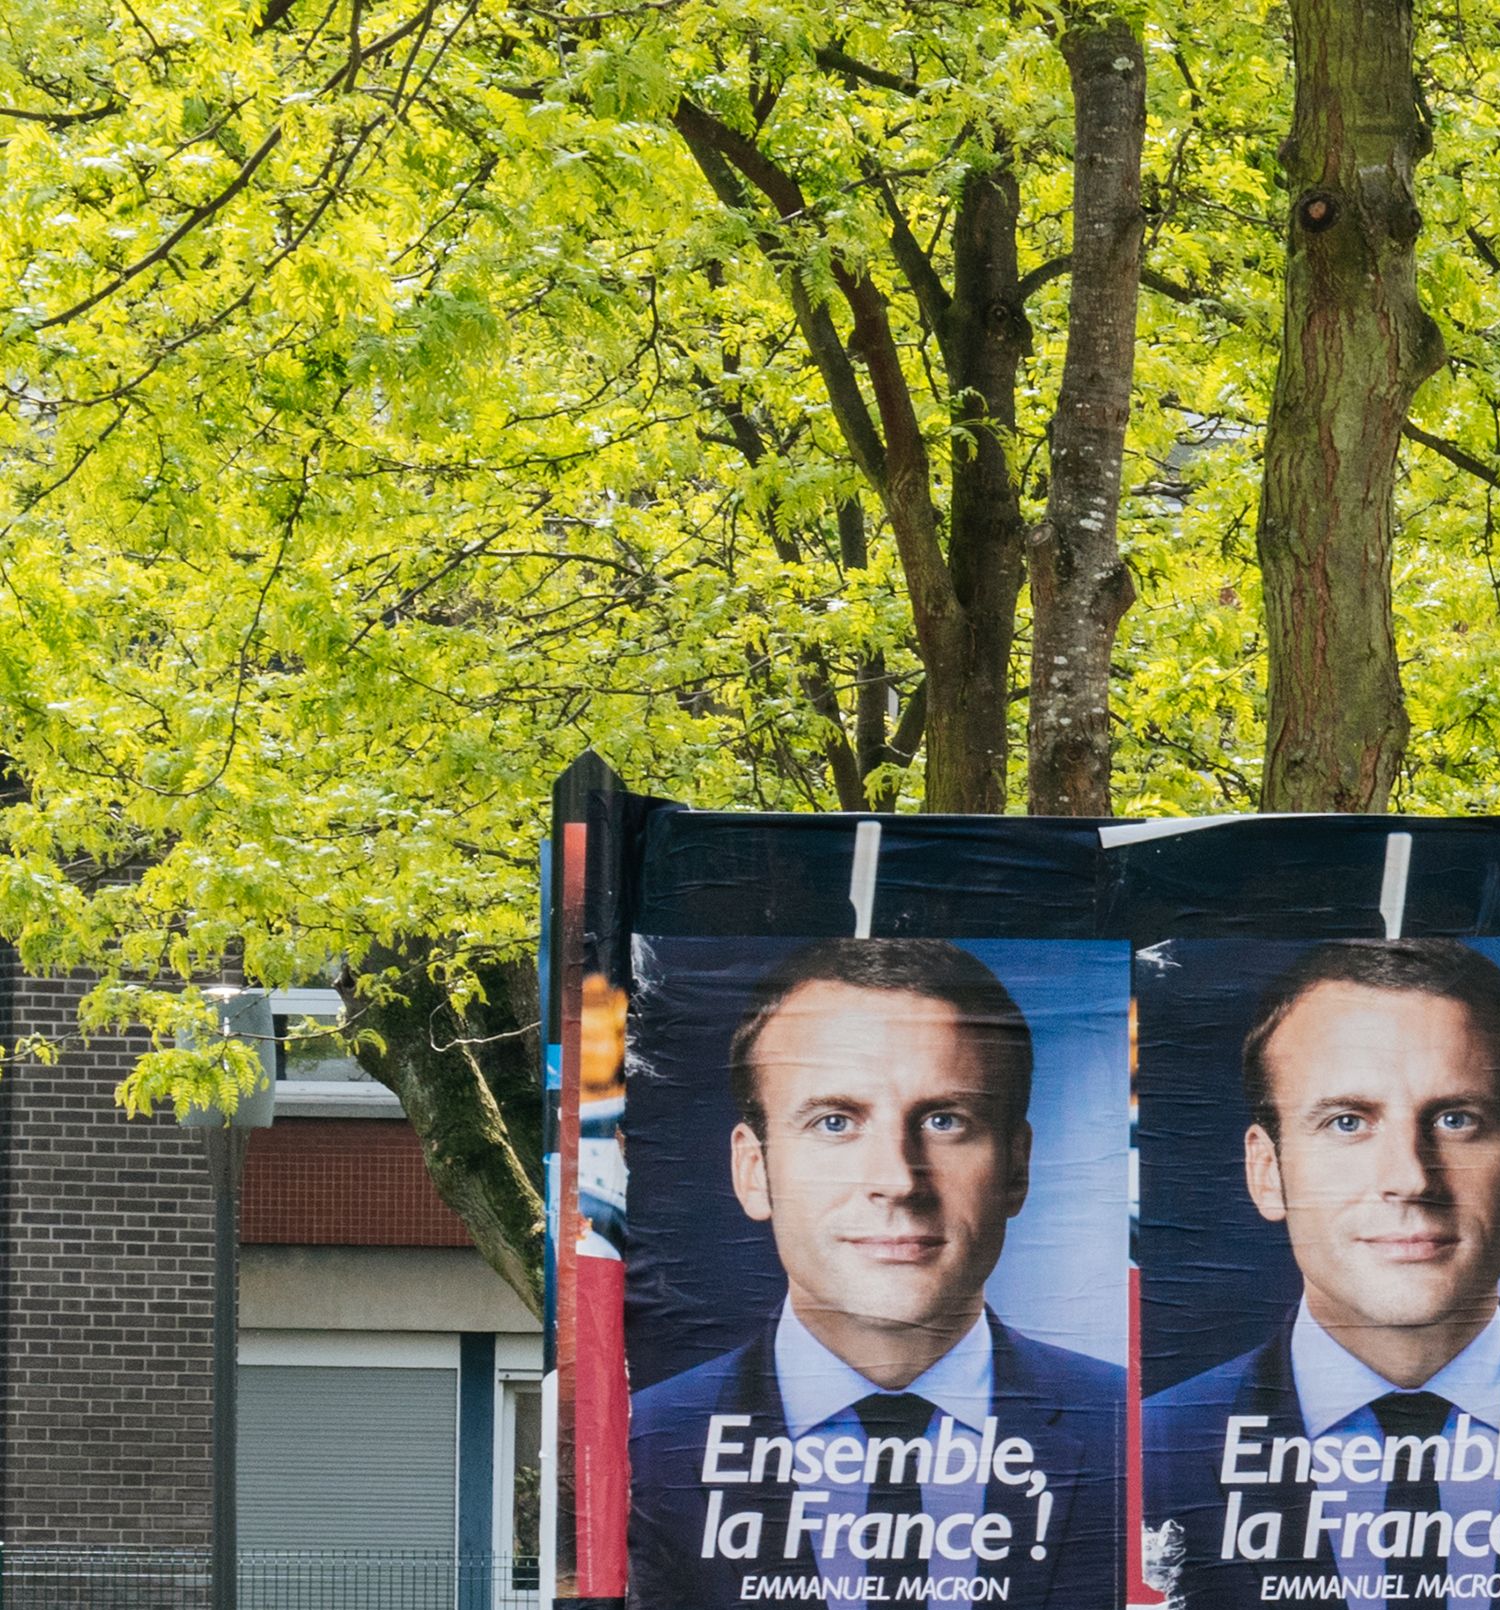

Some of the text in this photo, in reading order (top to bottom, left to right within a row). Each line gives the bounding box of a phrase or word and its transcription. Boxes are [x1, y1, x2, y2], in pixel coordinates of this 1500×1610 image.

[701, 1415, 1046, 1497] Ensemble,
[701, 1490, 763, 1559] la
[784, 1490, 1012, 1560] France
[1221, 1491, 1281, 1559] la
[740, 1576, 1010, 1600] EMMANUEL MACRON
[1261, 1574, 1409, 1600] EMMANUEL
